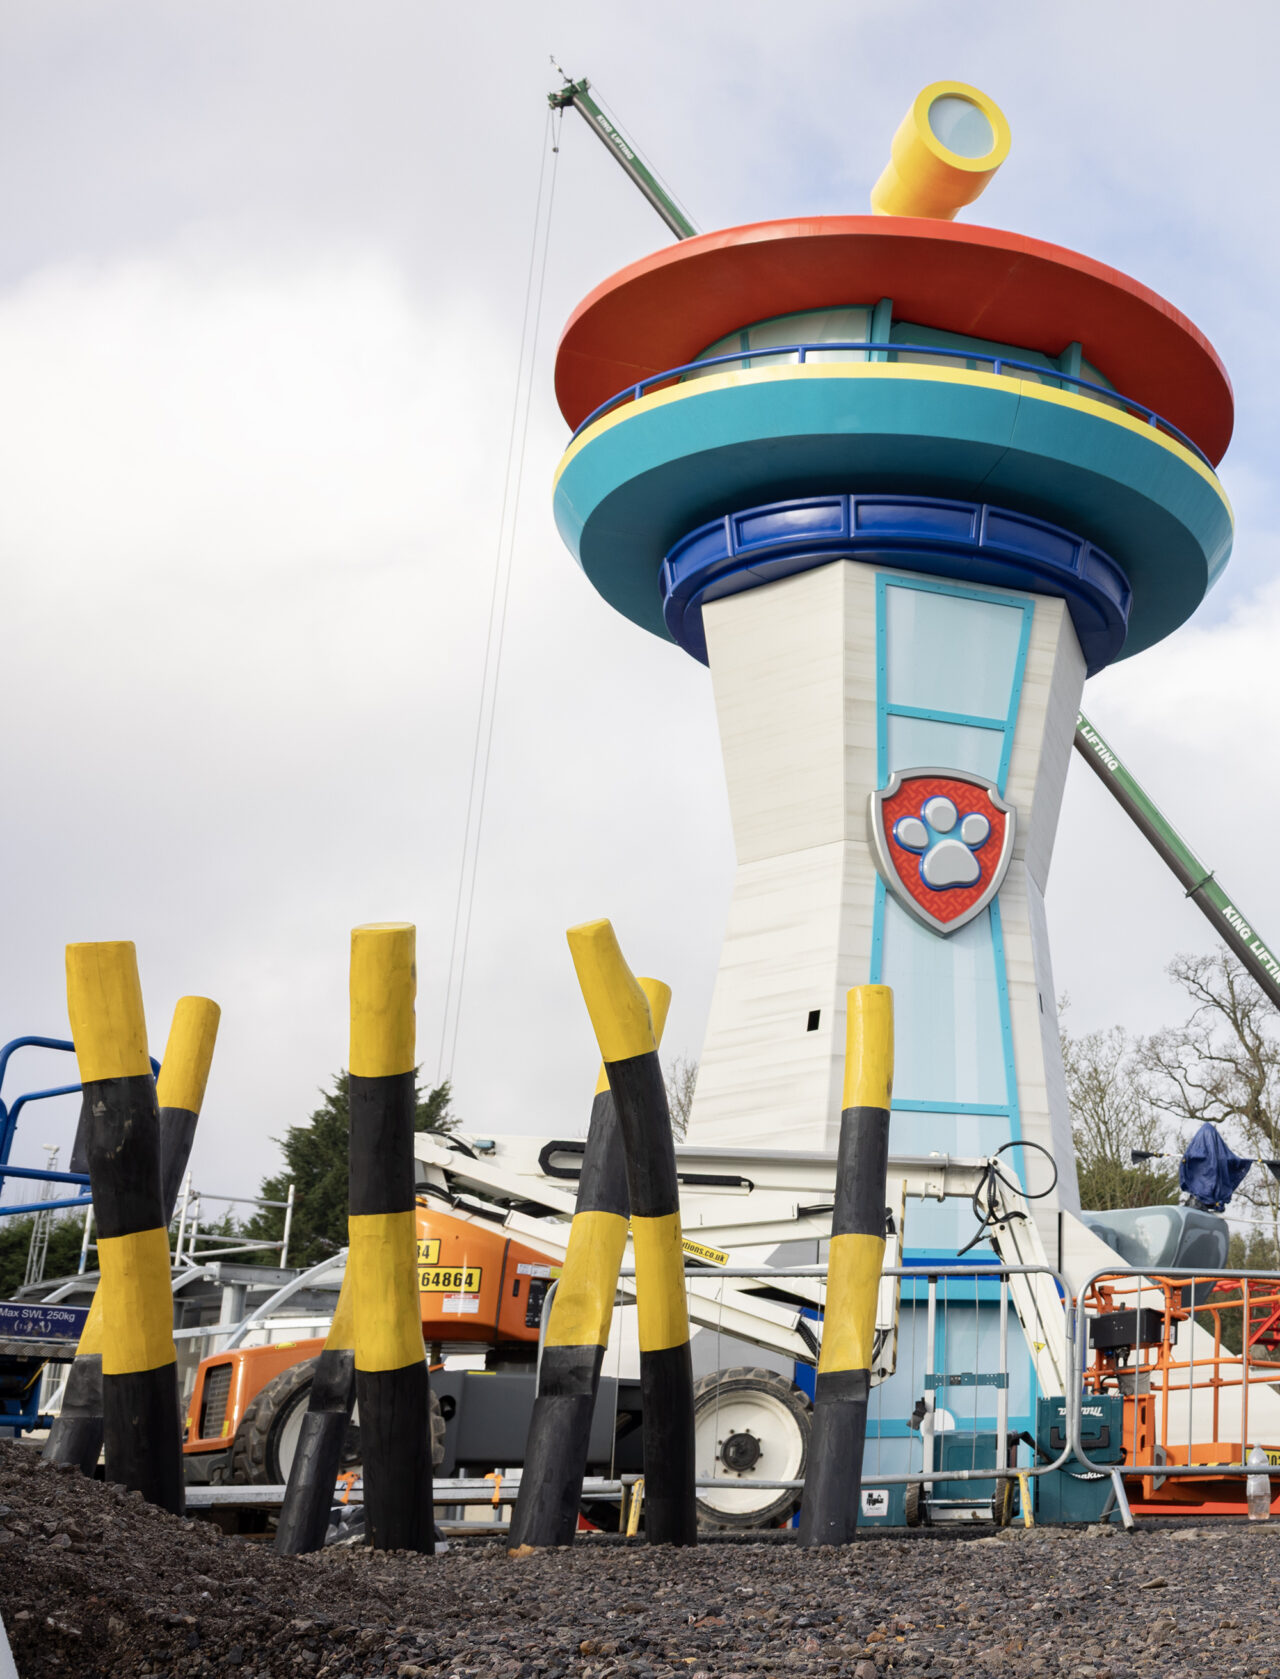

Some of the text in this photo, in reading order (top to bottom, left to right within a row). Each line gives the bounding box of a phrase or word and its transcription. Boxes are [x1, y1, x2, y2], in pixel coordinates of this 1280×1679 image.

[596, 114, 635, 160] KING LIFTING
[1080, 726, 1119, 771] LIFTING
[1222, 905, 1252, 940] KING
[418, 1272, 474, 1287] 64864
[0, 1308, 76, 1323] Max SWL 250kg
